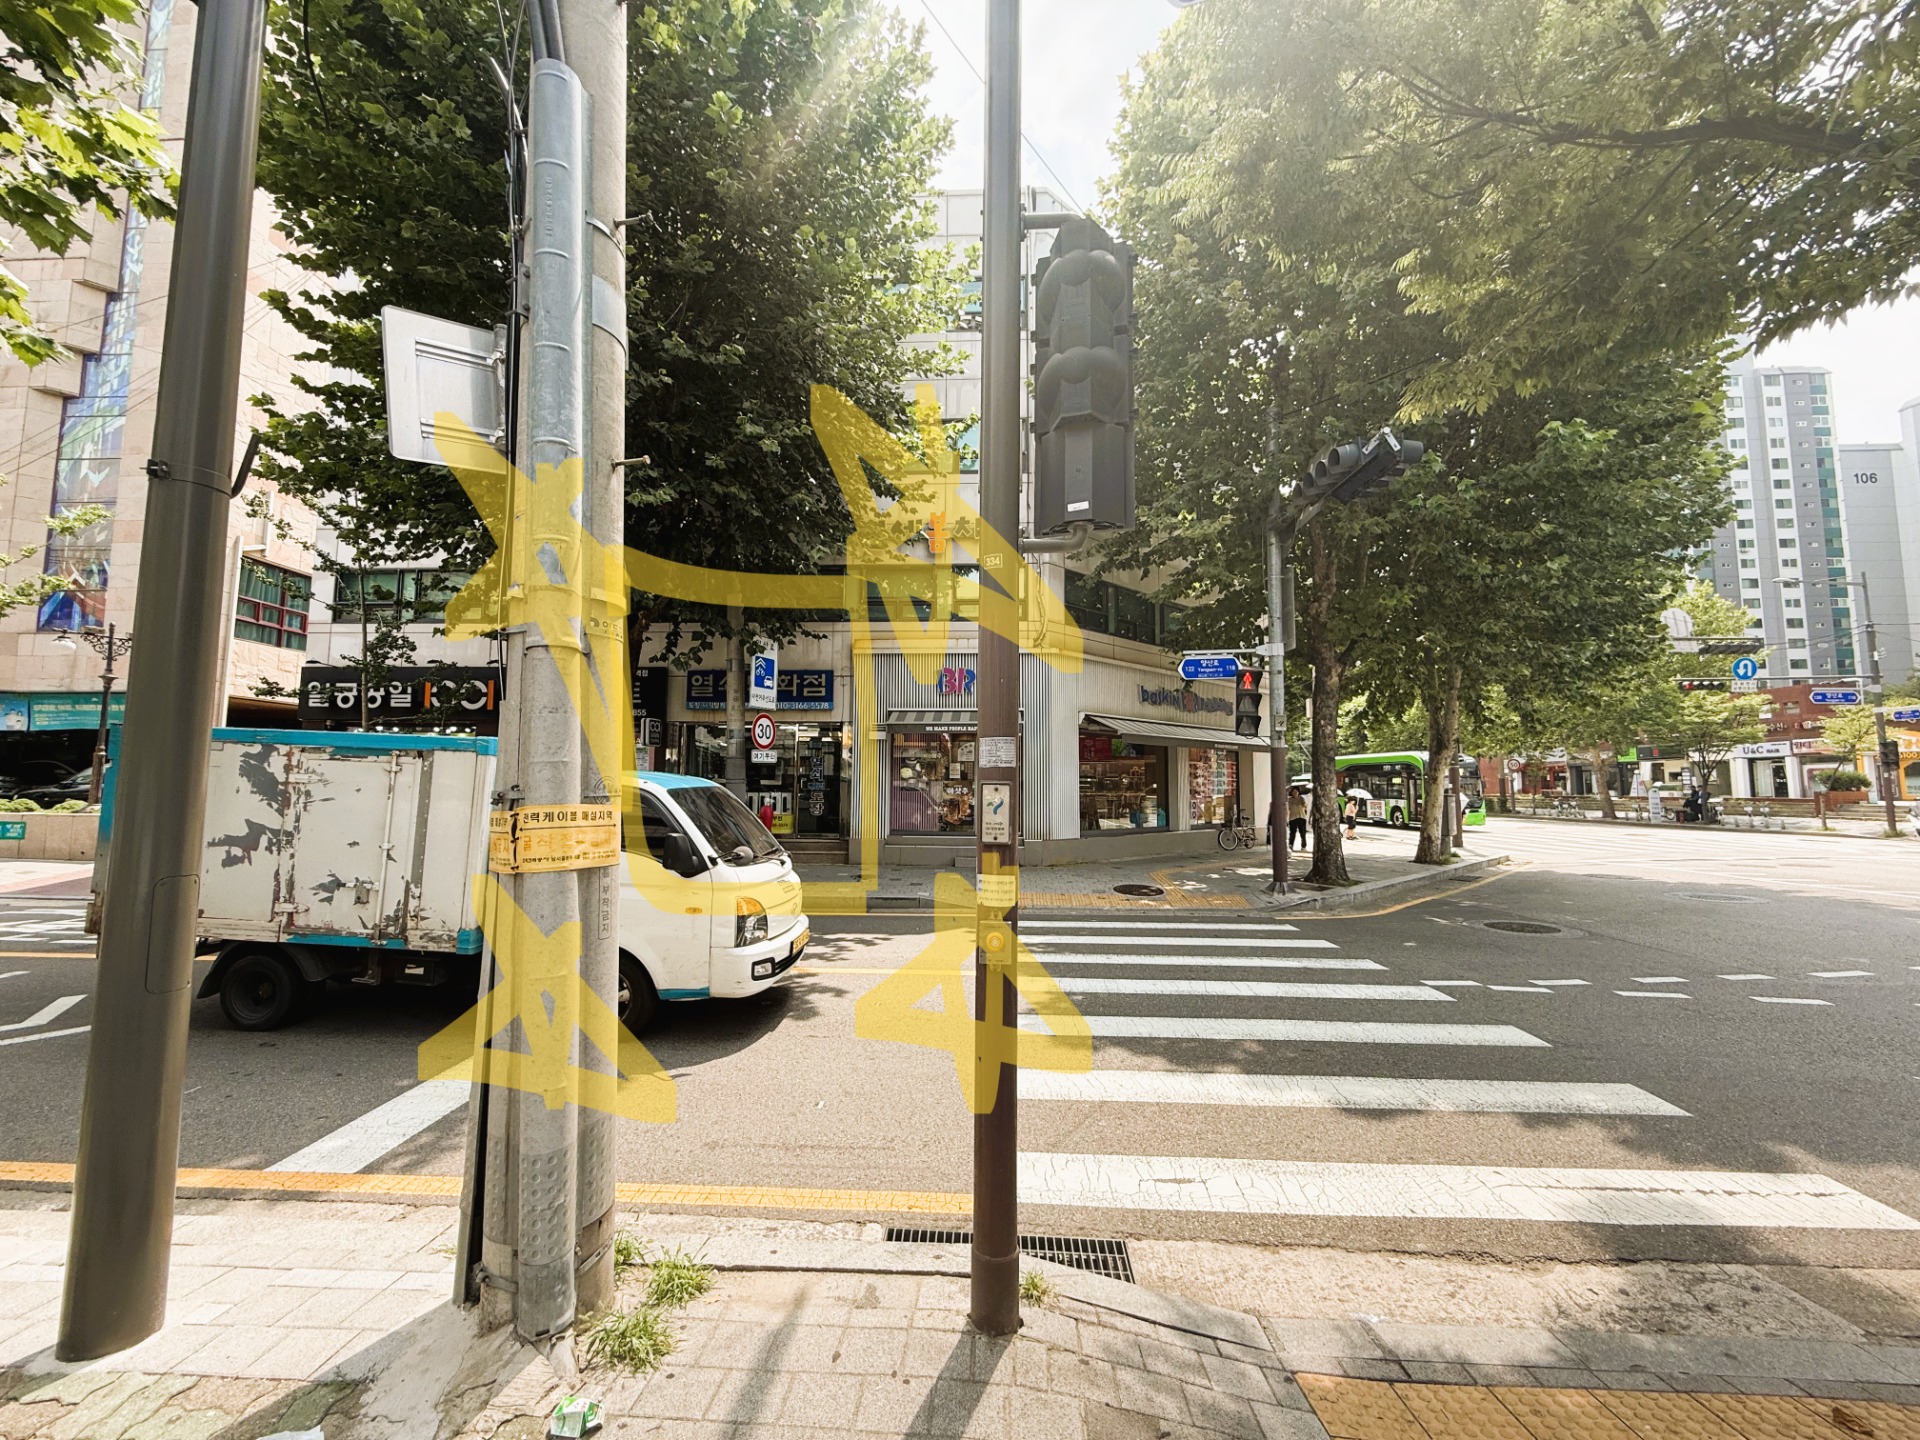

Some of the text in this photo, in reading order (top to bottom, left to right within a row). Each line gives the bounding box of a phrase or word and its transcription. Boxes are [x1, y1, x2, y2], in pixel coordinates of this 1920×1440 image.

[1853, 472, 1878, 484] 106
[985, 557, 1000, 566] 334
[1200, 659, 1220, 667] 양산로
[691, 674, 826, 697] 열화점
[937, 667, 976, 695] BR
[757, 723, 772, 739] 30
[1742, 744, 1764, 755] U&C
[752, 752, 776, 761] 여기부터
[523, 810, 613, 824] 전력케이블 매설지역
